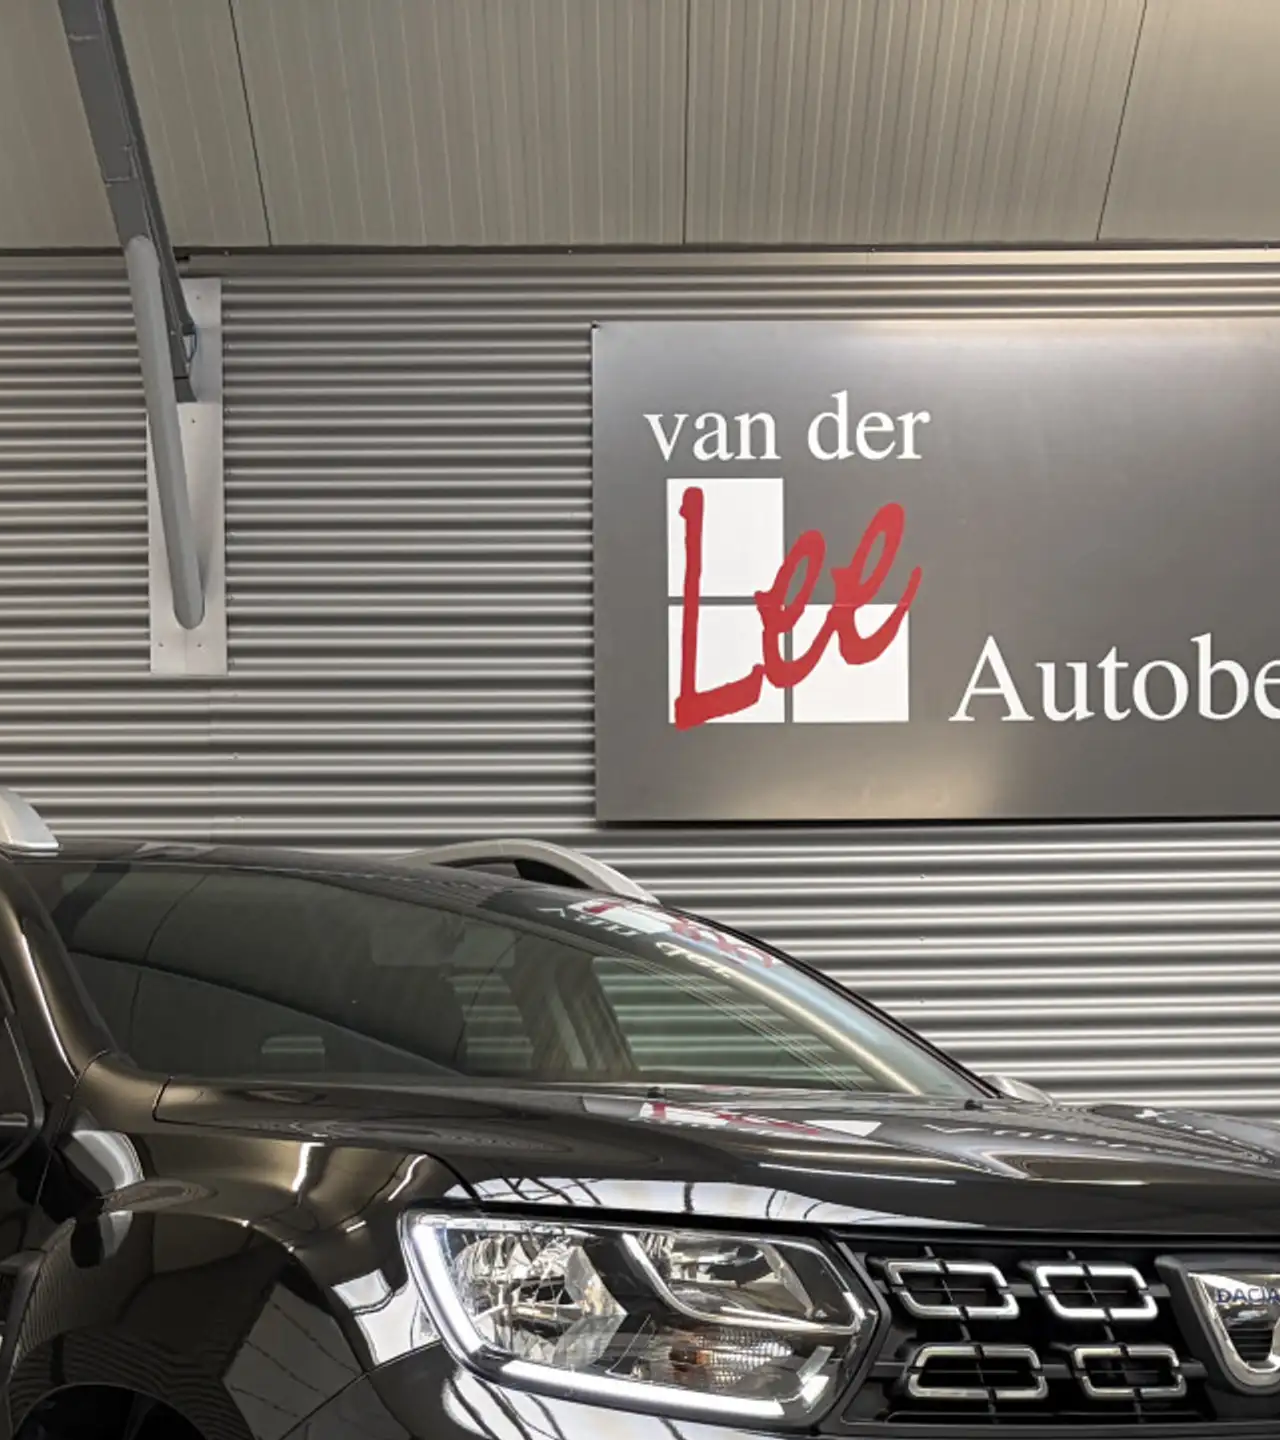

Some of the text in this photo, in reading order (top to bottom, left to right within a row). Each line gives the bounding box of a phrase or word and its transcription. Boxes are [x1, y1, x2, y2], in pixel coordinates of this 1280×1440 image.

[643, 389, 931, 461] van der
[674, 486, 923, 731] Lee
